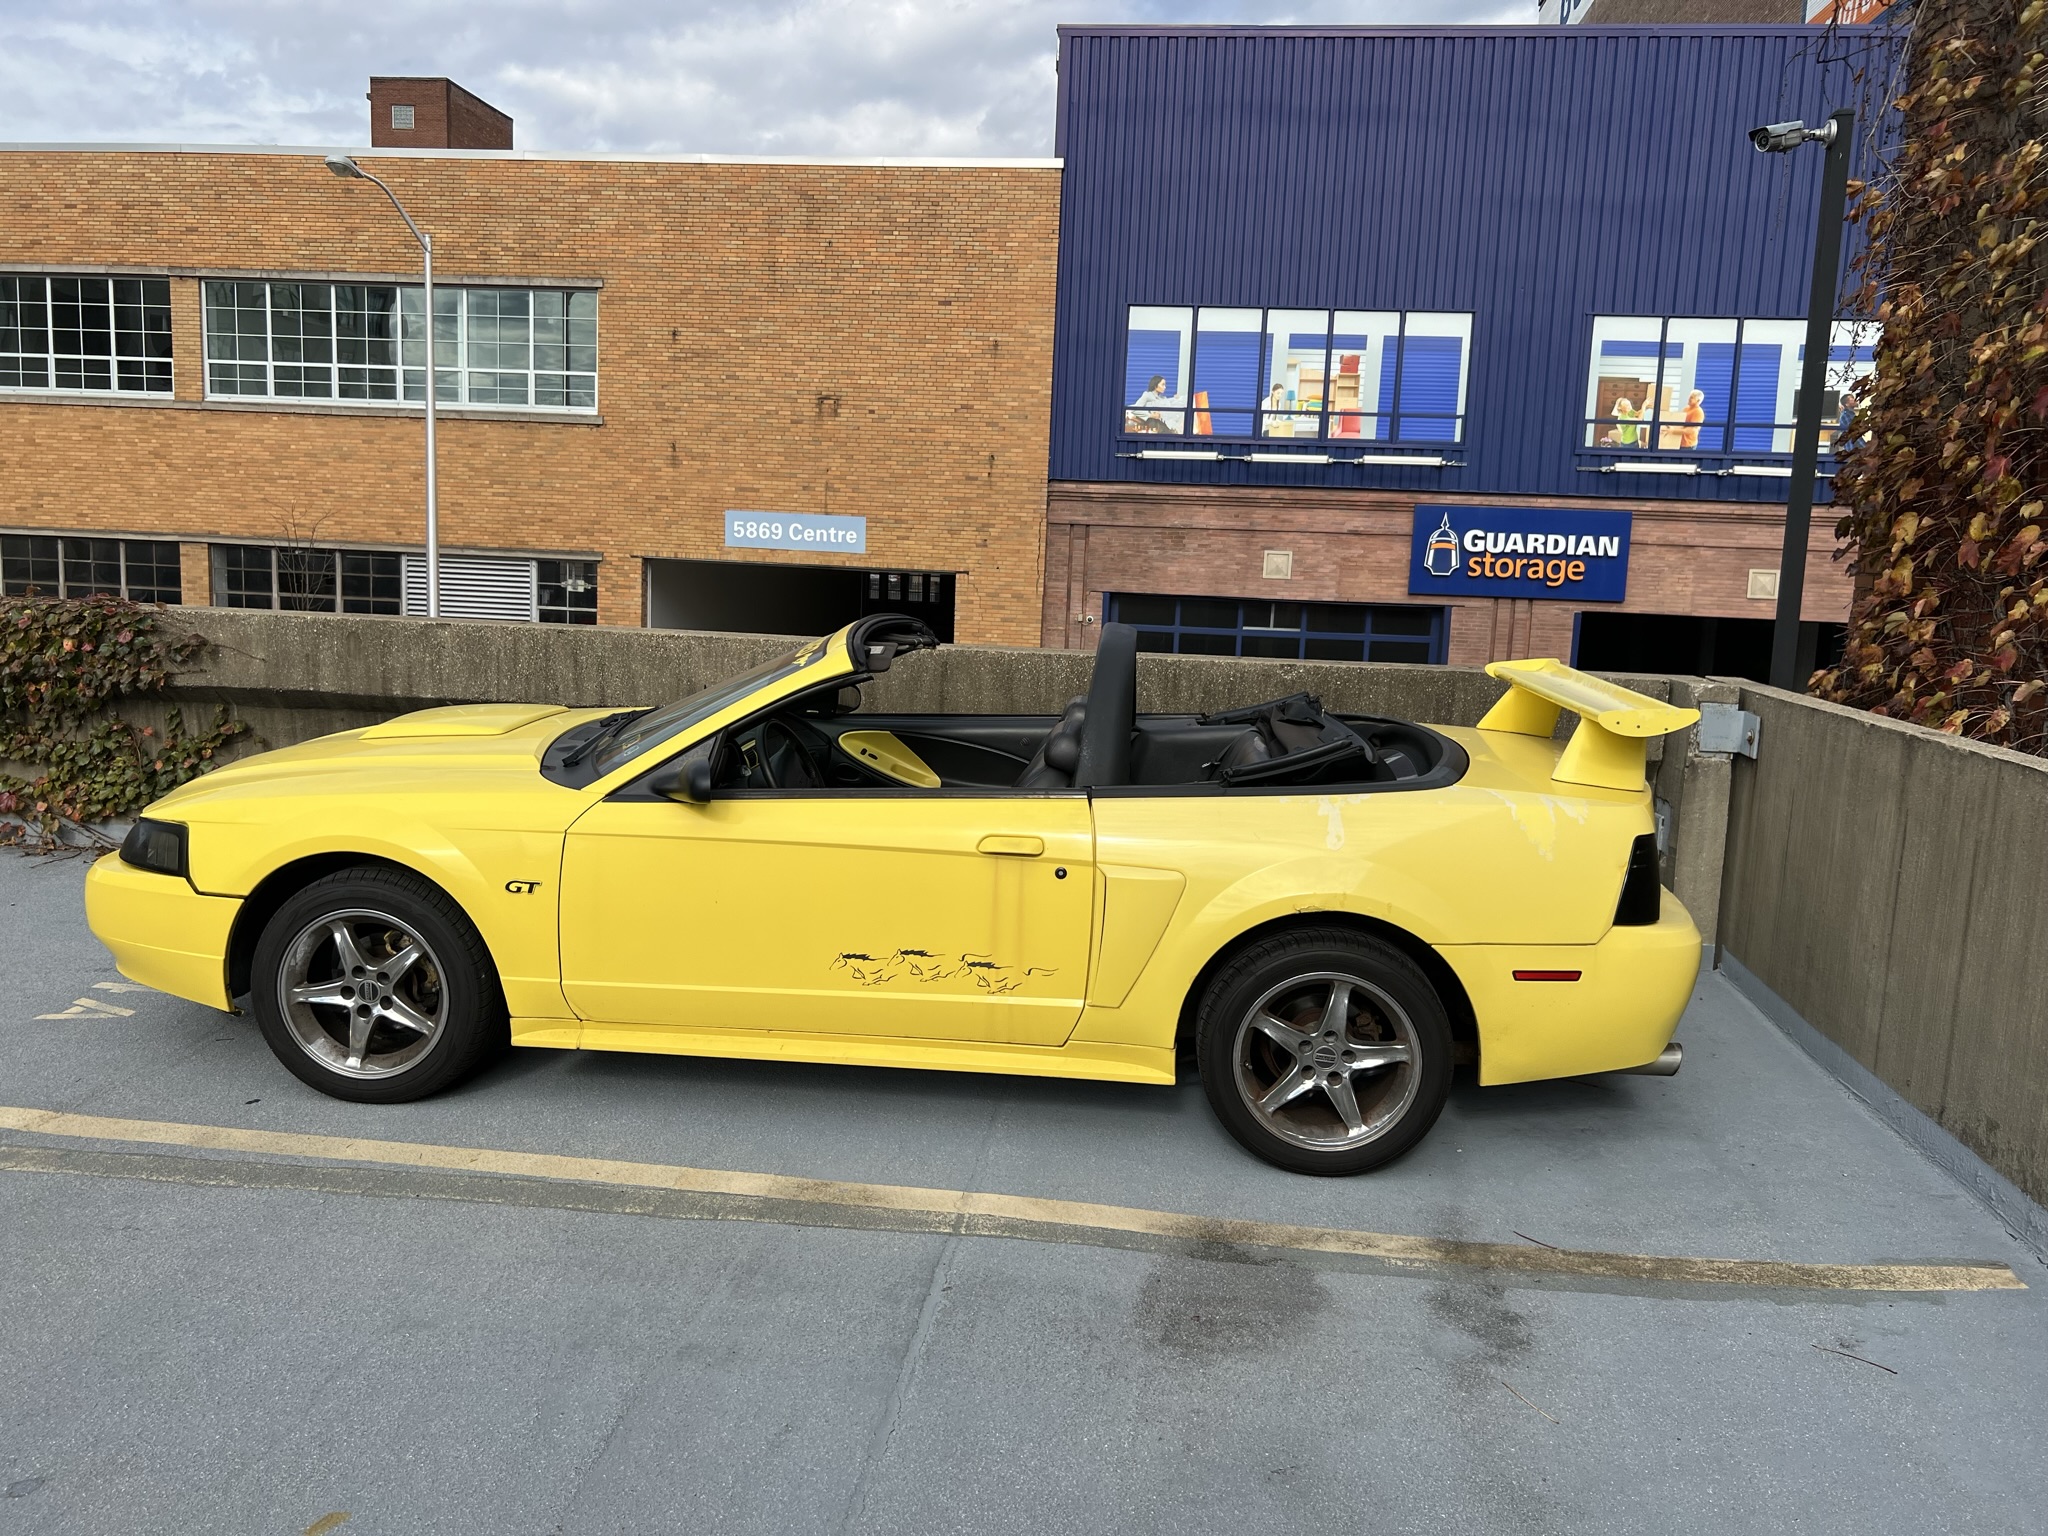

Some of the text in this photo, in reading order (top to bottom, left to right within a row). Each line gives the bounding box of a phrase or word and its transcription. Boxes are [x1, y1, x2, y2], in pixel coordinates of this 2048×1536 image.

[733, 521, 857, 544] 5869 Centre
[1463, 529, 1620, 557] GUARDIAN
[1467, 552, 1585, 587] storage
[504, 880, 541, 894] GT
